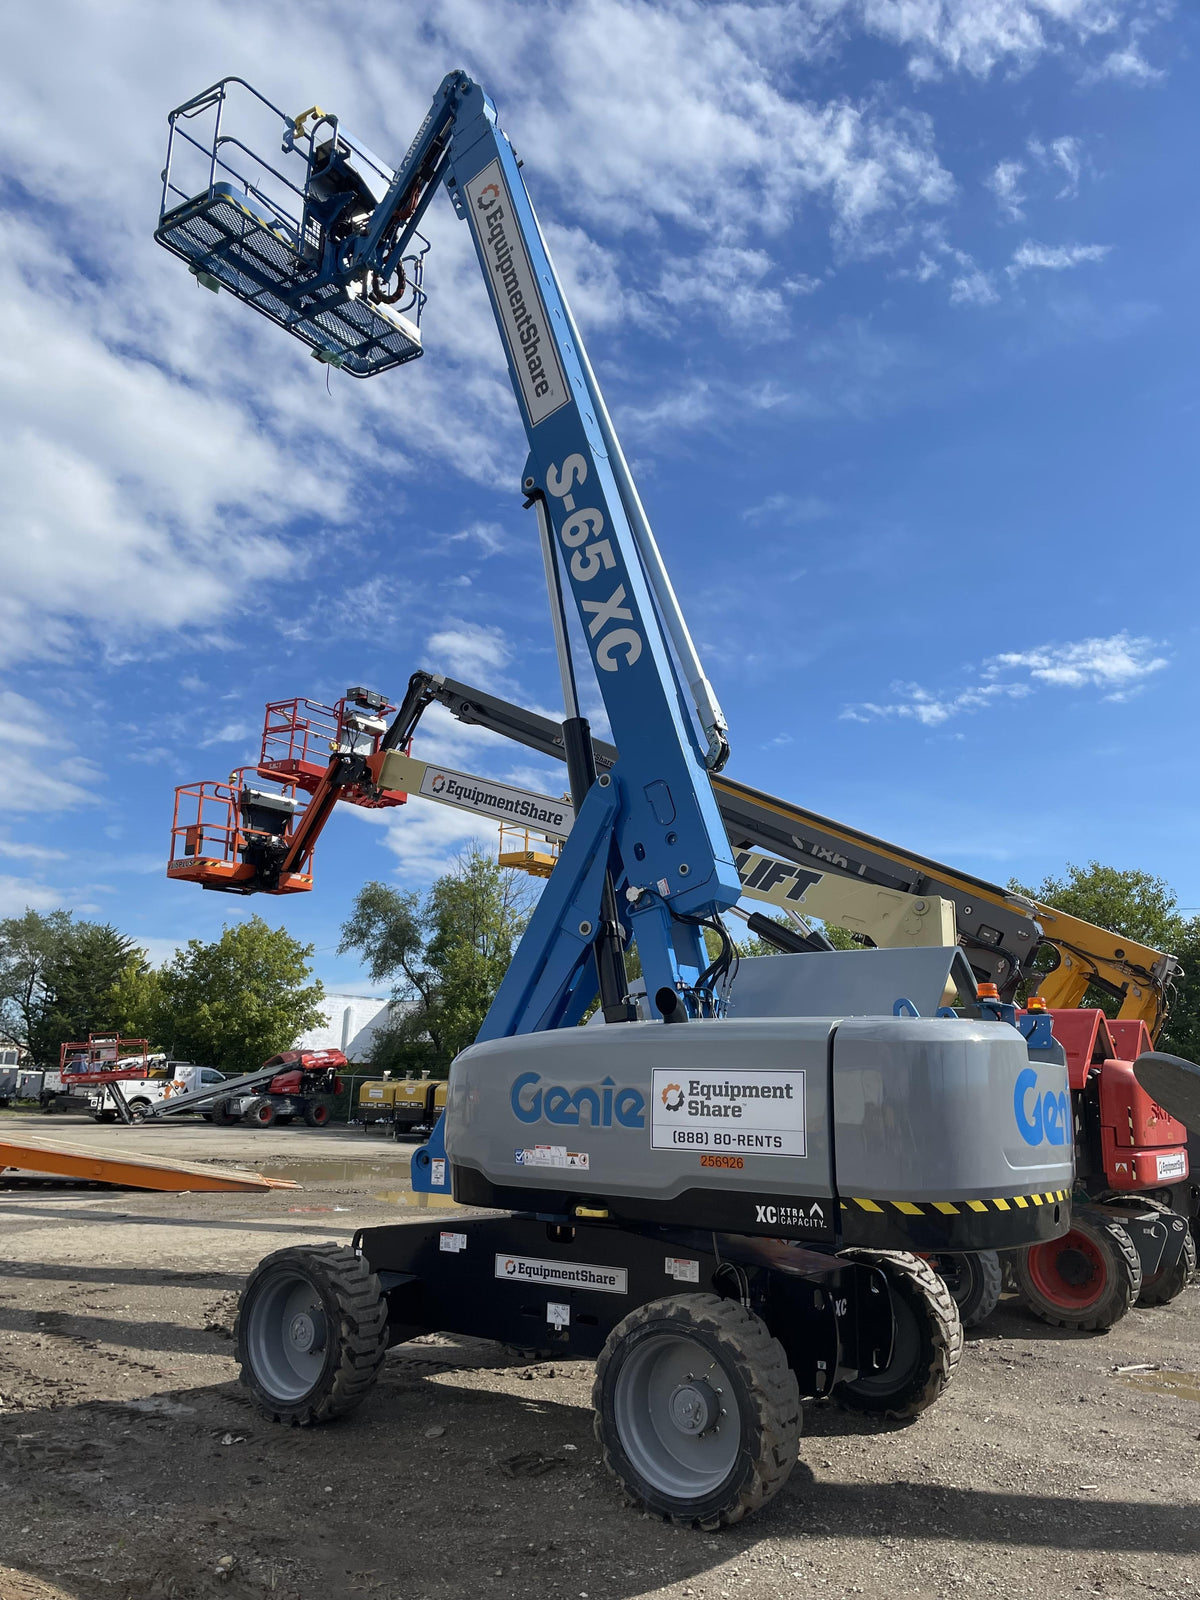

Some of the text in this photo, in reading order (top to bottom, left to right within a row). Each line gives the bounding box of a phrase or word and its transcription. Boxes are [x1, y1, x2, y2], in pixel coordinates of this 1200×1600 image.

[486, 205, 550, 398] EquipmentShare
[546, 452, 643, 672] S-65 XC
[445, 779, 564, 826] EquipmentShare
[511, 1072, 646, 1128] Genie
[688, 1080, 794, 1101] Equipment
[688, 1100, 742, 1118] Share
[673, 1130, 783, 1148] (888) 80-RENTS
[701, 1155, 744, 1169] 256926
[755, 1205, 805, 1224] XC XTRA
[780, 1216, 824, 1228] CAPACITY
[518, 1262, 616, 1285] EquipmentShare
[835, 1298, 848, 1317] XC
